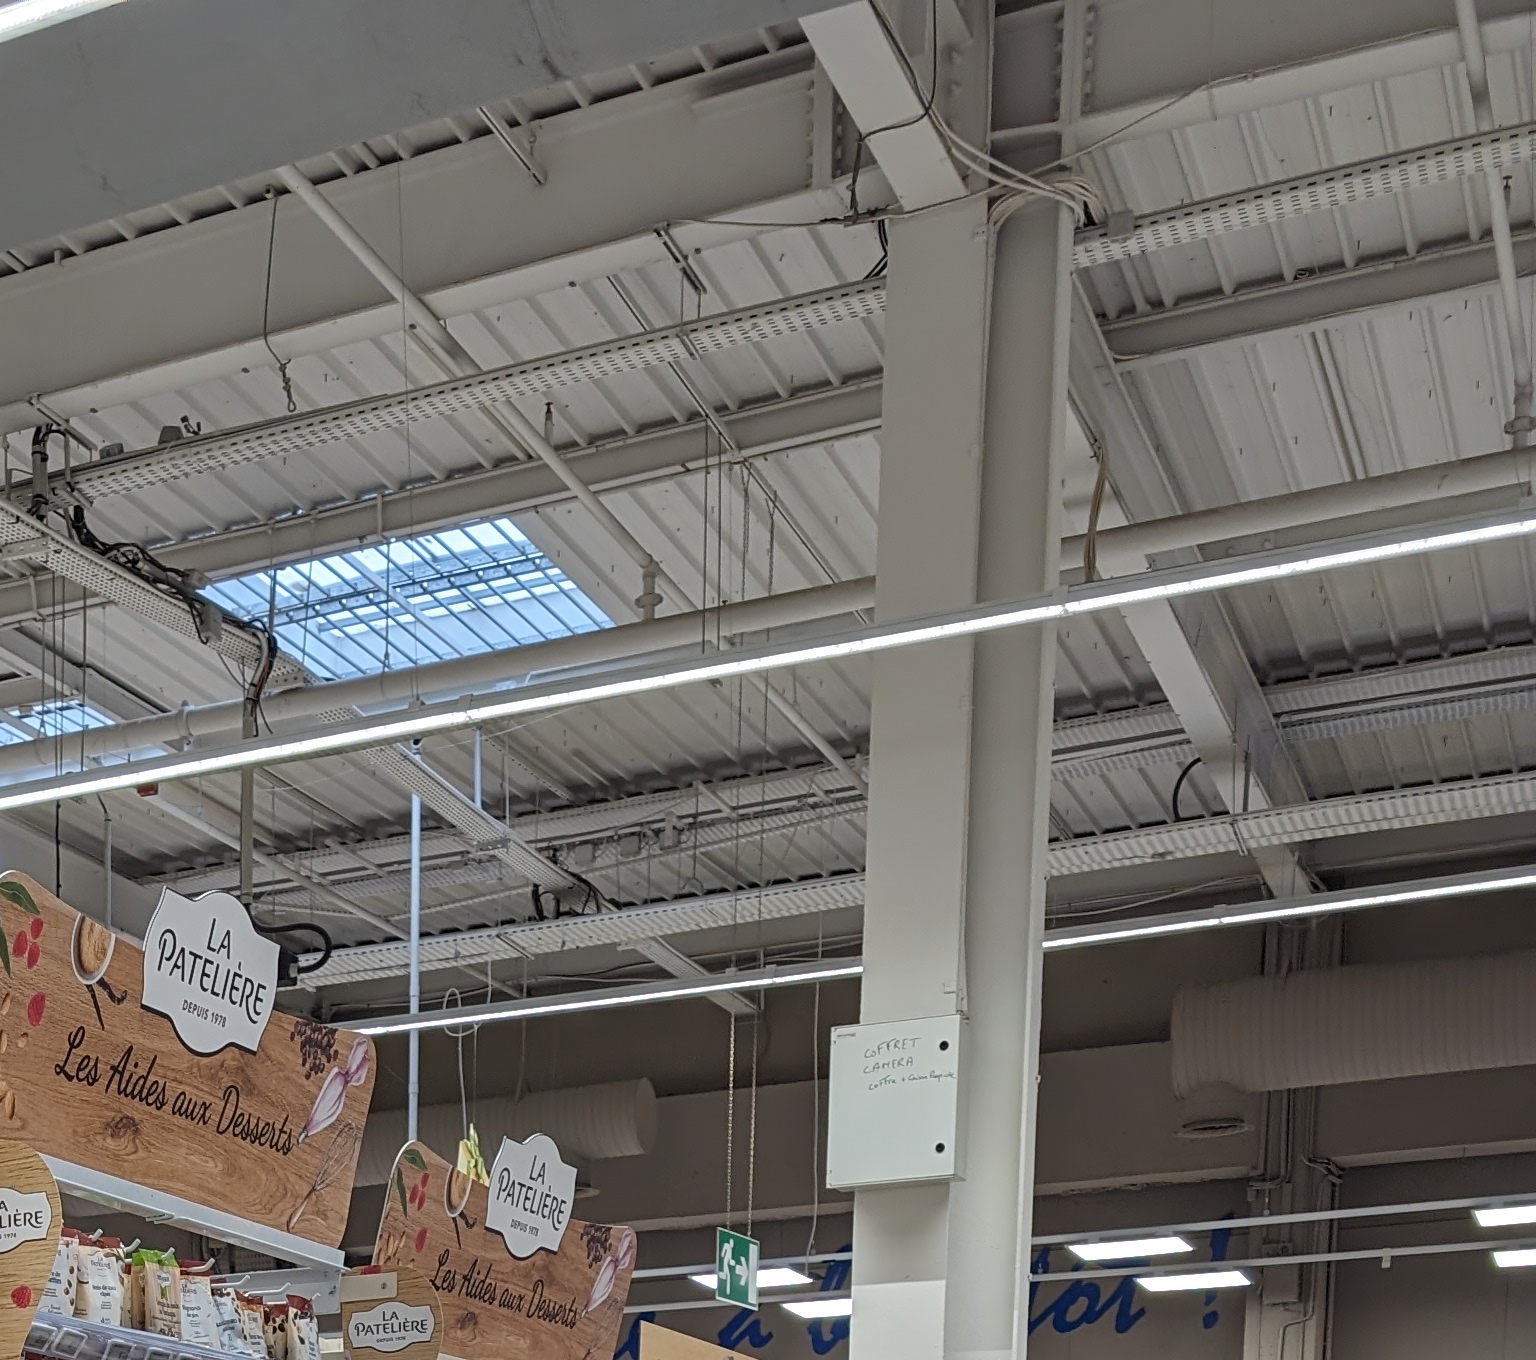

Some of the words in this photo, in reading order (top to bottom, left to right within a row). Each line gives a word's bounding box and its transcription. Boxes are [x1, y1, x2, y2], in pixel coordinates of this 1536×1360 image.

[208, 918, 231, 953] LA
[157, 928, 267, 1024] PATELIÈRE
[182, 1000, 209, 1022] DEPUIS
[211, 1011, 226, 1028] 1978
[54, 1027, 100, 1086] Les
[105, 1044, 167, 1110] Aides
[173, 1091, 212, 1125] aux
[216, 1085, 293, 1155] Desserts
[529, 1155, 545, 1185] LA
[496, 1167, 567, 1231] PATELIÈRE
[429, 1249, 456, 1293] Les
[458, 1259, 497, 1304] Aides
[499, 1287, 525, 1312] aux
[525, 1279, 579, 1328] Desserts
[354, 1317, 428, 1337] PATELIÈRE
[382, 1311, 399, 1322] LA
